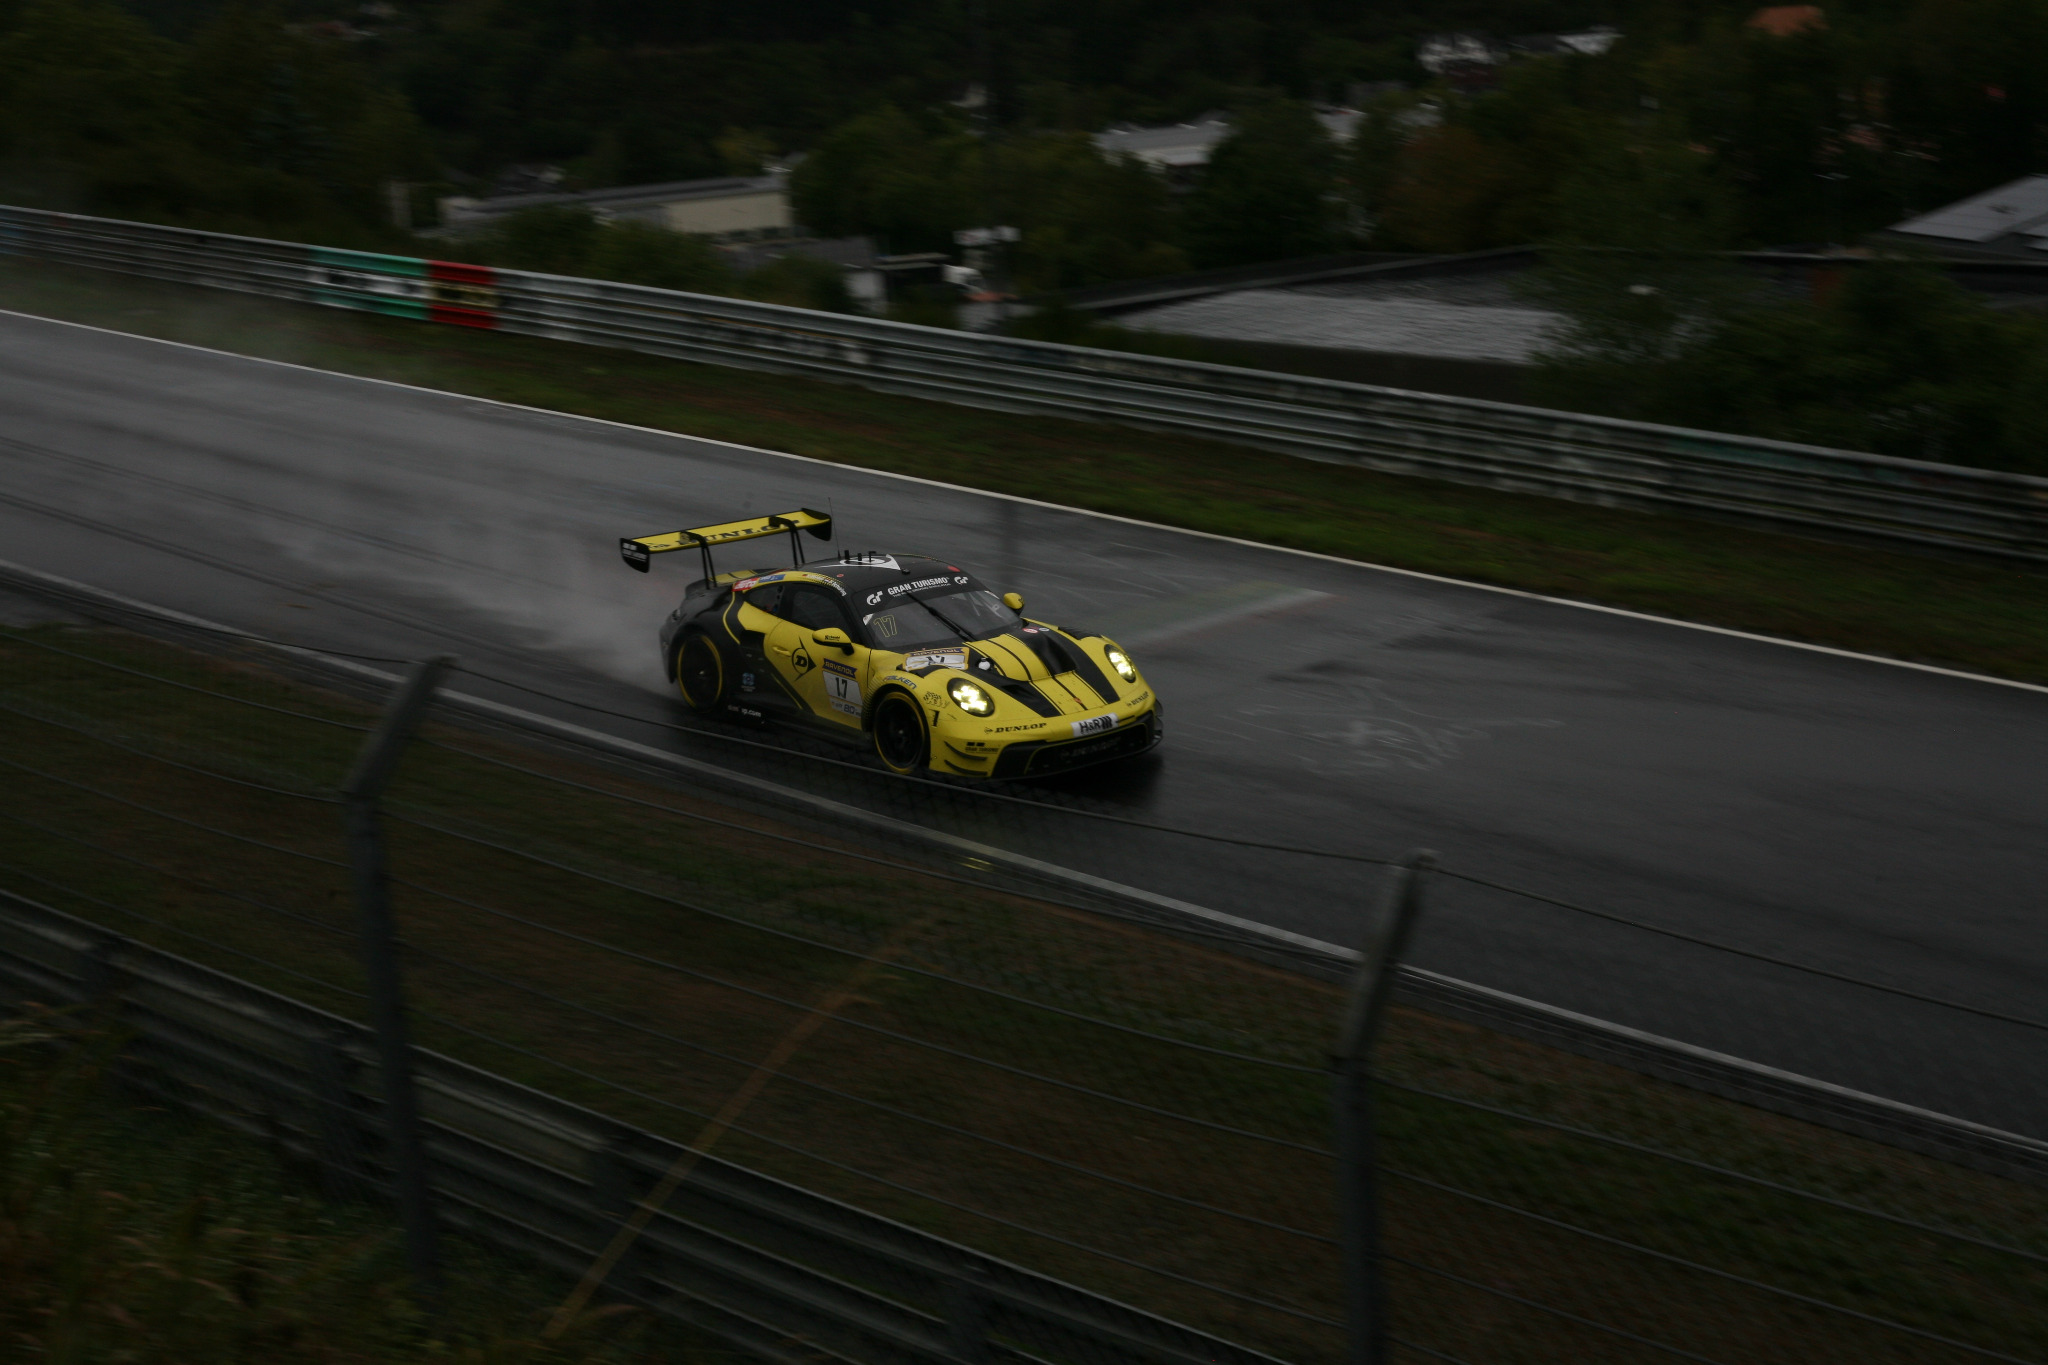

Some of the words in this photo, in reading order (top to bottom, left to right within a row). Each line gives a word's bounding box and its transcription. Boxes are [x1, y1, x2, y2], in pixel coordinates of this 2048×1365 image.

[887, 584, 912, 596] GRAN
[911, 576, 948, 589] TURISMO
[873, 614, 898, 637] 17
[825, 661, 854, 676] RAVENOL
[835, 677, 848, 699] 17
[995, 722, 1047, 733] DUNLOP
